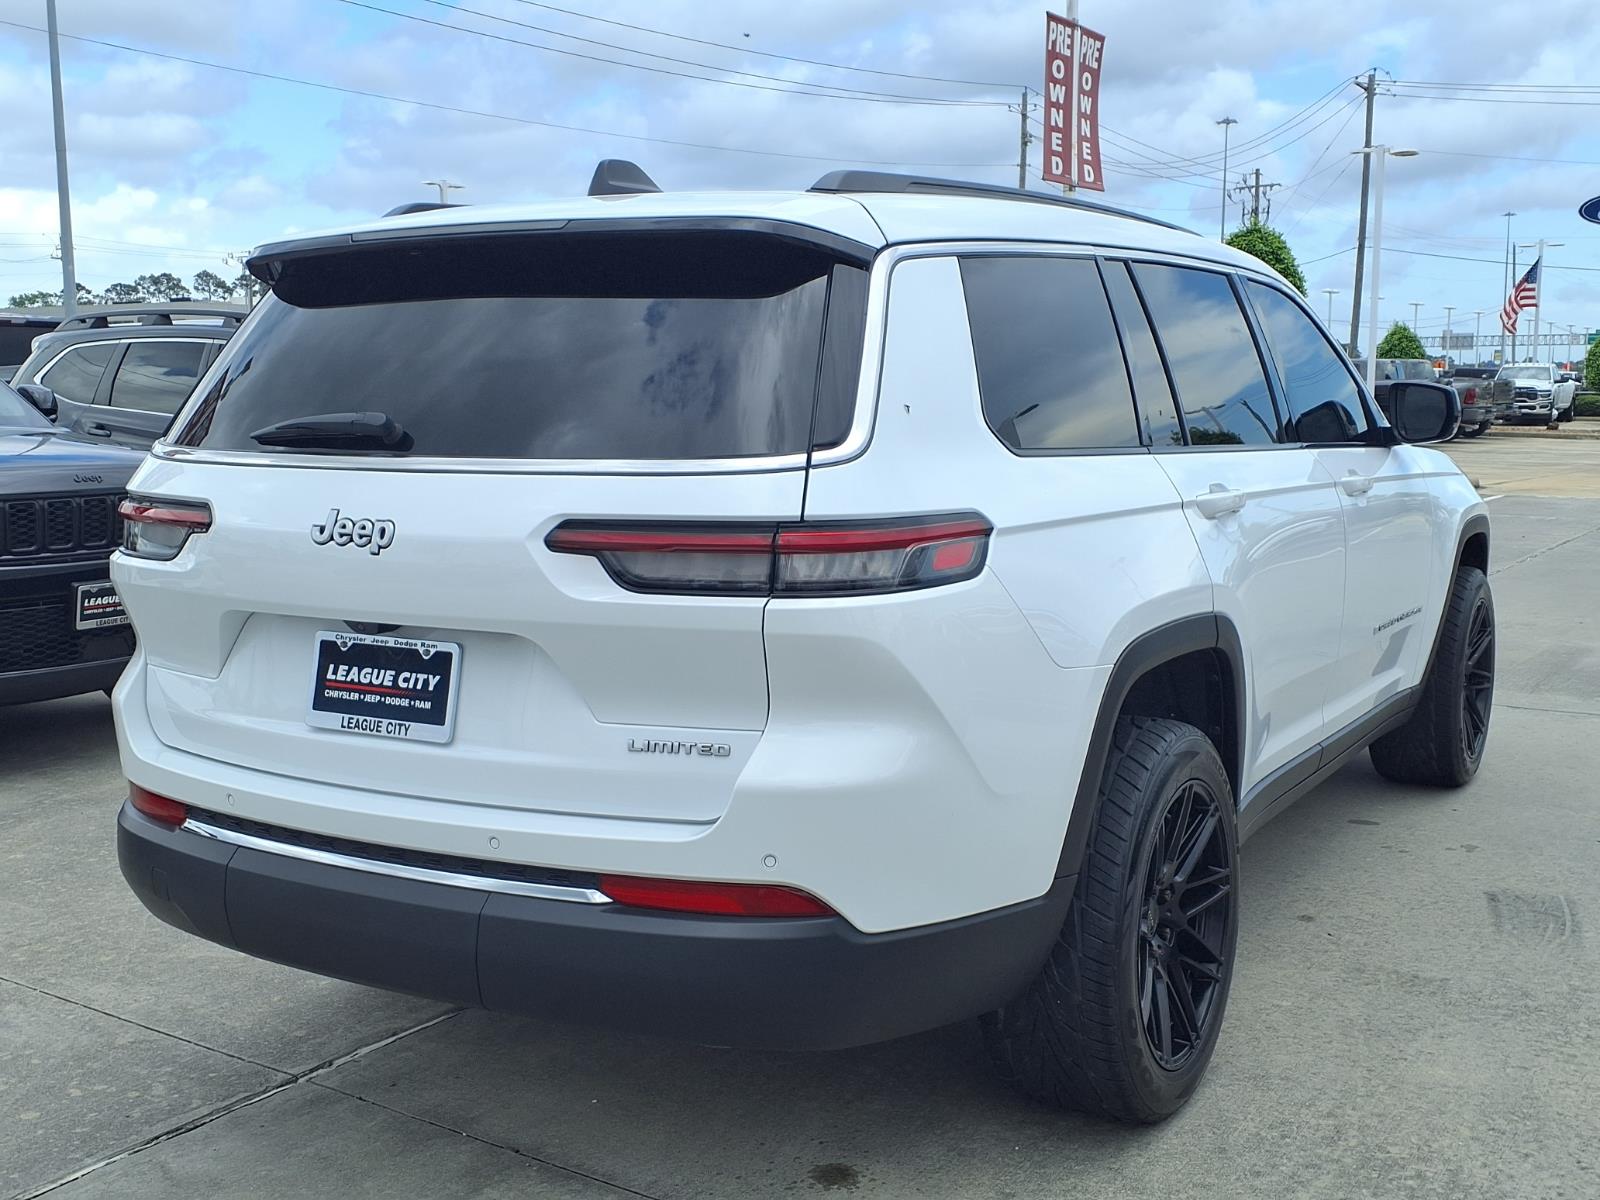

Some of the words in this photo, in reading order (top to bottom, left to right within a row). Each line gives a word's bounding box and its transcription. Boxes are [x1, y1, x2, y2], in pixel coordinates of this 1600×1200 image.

[1048, 21, 1072, 57] PRE
[1080, 35, 1101, 70] PRE
[1049, 59, 1066, 176] OWNED
[1080, 71, 1095, 183] OWNED
[311, 508, 396, 556] Jeep
[335, 633, 367, 643] Chrysler
[394, 640, 418, 648] Dodge
[326, 663, 396, 686] LEAGUE
[398, 671, 441, 691] CITY
[324, 689, 359, 701] CHRYSLER
[364, 695, 381, 703] JEEP
[385, 696, 410, 707] DODGE
[415, 700, 431, 710] RAM
[340, 716, 383, 733] LEAGUE
[386, 722, 411, 737] CITY
[627, 739, 731, 757] LIMITED
